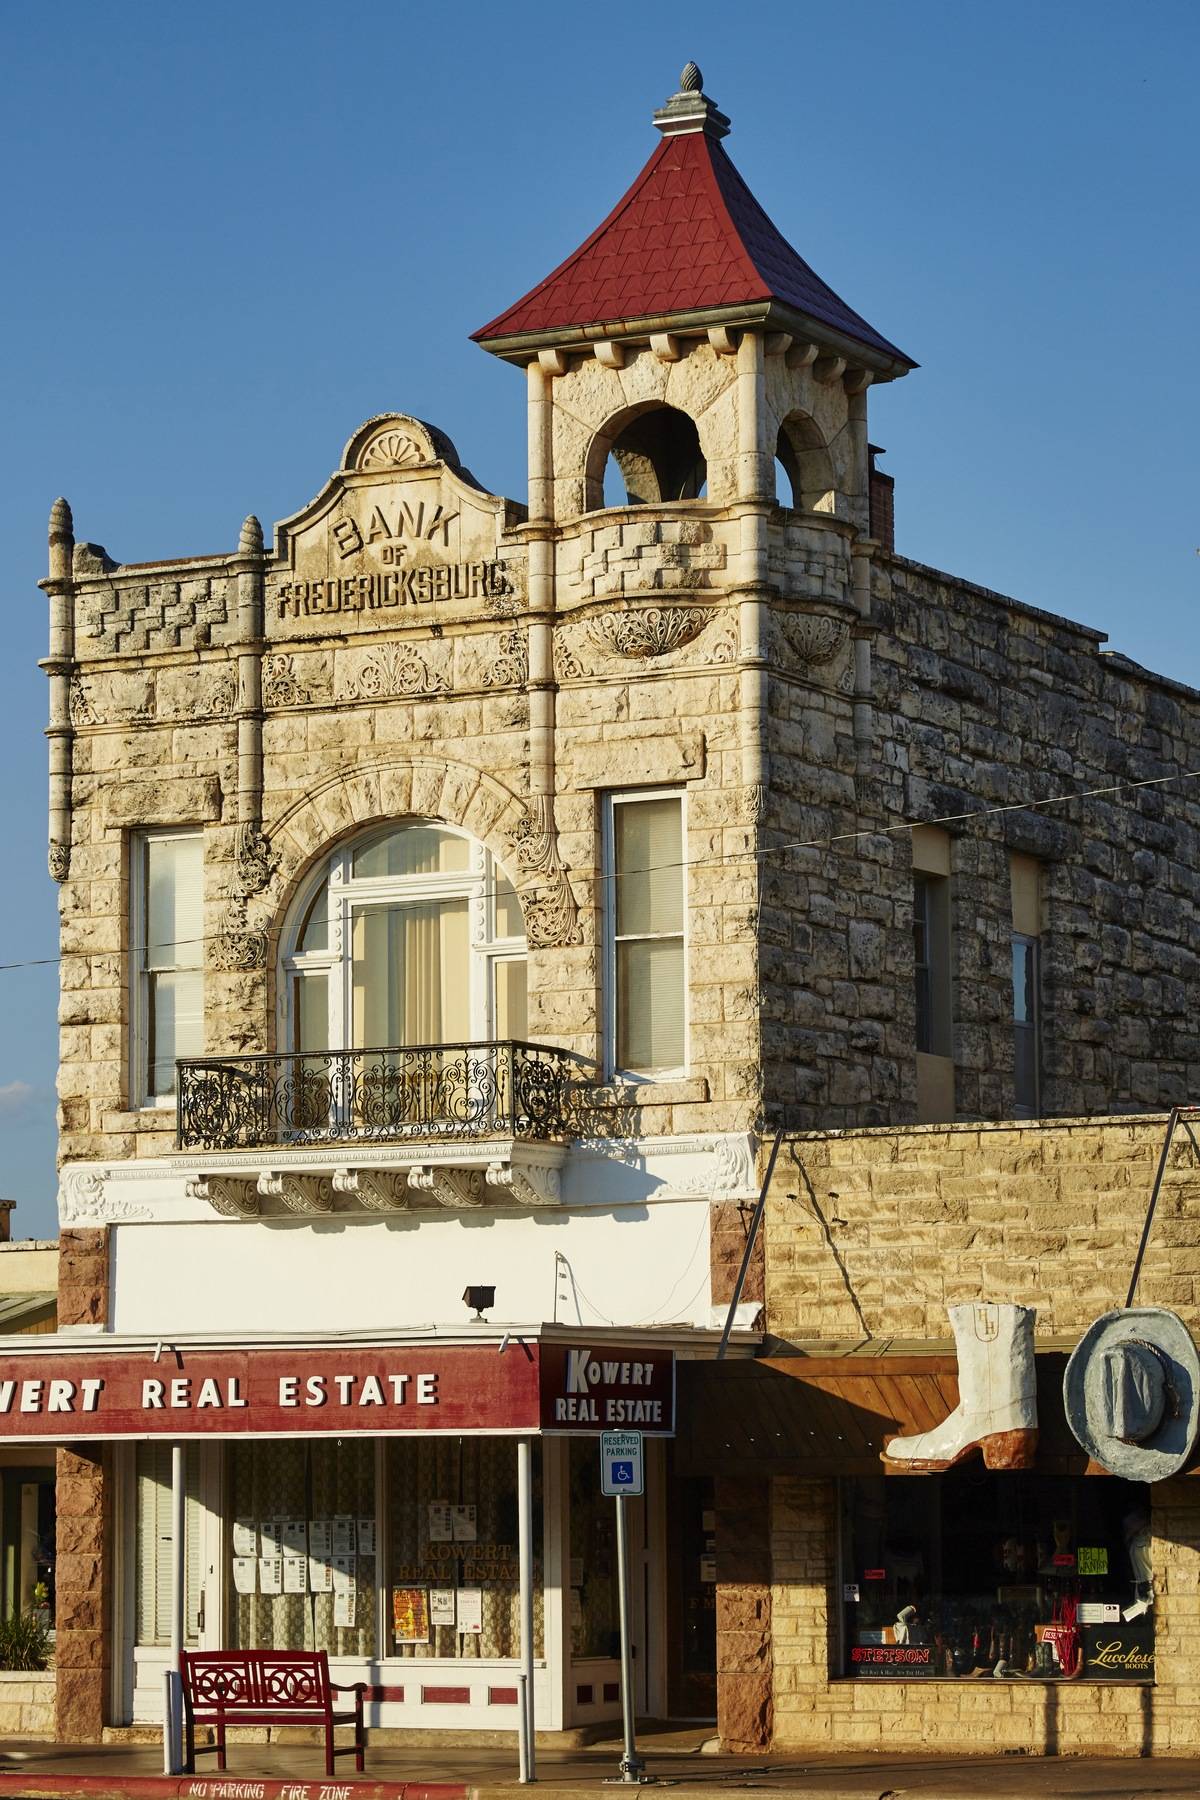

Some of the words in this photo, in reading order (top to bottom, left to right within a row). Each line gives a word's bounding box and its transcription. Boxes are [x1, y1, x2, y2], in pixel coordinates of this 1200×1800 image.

[328, 499, 461, 561] BANK
[382, 544, 408, 567] OF
[277, 560, 513, 618] FREDERICKSBURG
[566, 1350, 654, 1393] KOWERT
[142, 1377, 248, 1409] REAL
[279, 1374, 438, 1408] ESTATE
[555, 1398, 600, 1422] REAL
[606, 1399, 663, 1423] ESTATE
[603, 1436, 639, 1446] RESERVED
[606, 1447, 638, 1457] PARKING
[423, 1544, 513, 1561] KOWERT
[400, 1564, 450, 1580] REAL
[850, 1647, 930, 1663] STETSON
[1088, 1641, 1156, 1669] Lucchese
[189, 1782, 208, 1798] NO
[211, 1781, 266, 1799] PARKING
[280, 1784, 312, 1800] FIRE
[319, 1785, 355, 1800] ZONE
